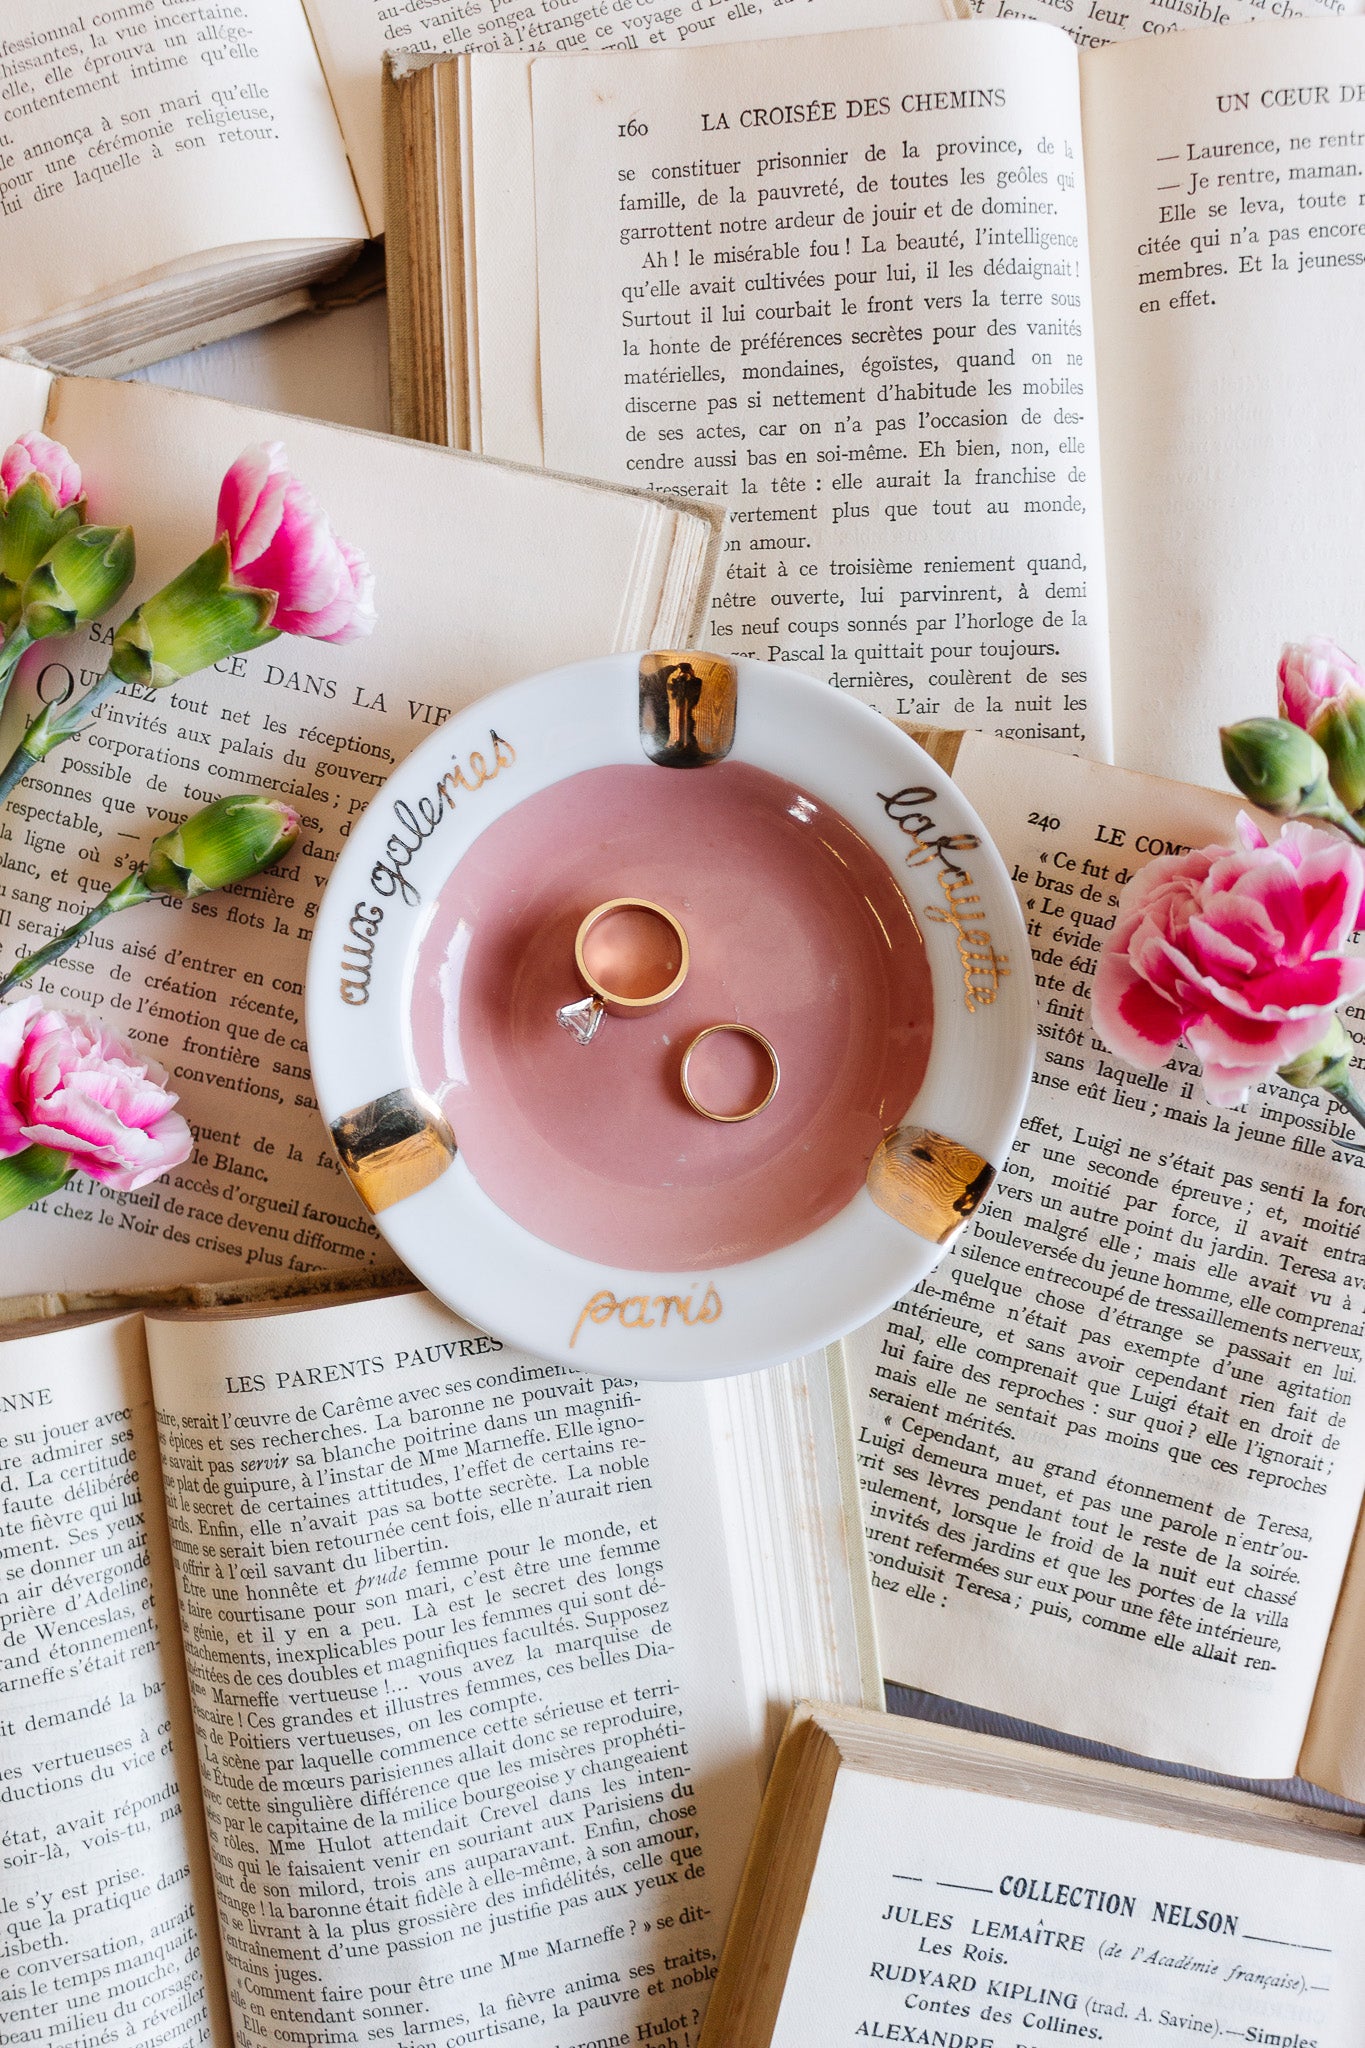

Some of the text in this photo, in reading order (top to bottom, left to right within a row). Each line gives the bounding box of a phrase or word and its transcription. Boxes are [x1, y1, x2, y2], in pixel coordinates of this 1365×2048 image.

[384, 1, 482, 40] des vanités
[442, 8, 536, 45] elle songea
[502, 4, 608, 46] à l'étrangeté
[4, 54, 189, 123] contentement intime
[1215, 86, 1330, 114] UN CŒUR
[23, 89, 202, 161] annonça à son mari
[617, 88, 1006, 138] 160 LA CROISÉE DES CHEMINS
[44, 120, 175, 174] une cérémonie
[73, 127, 279, 187] laquelle à son retour.
[1186, 139, 1280, 162] Laurence,
[619, 165, 1075, 211] famille, de la pauvreté, de toutes les geôles qui
[1186, 164, 1363, 196] Je rentre, maman.
[1158, 191, 1347, 224] Elle se leva, toute
[1137, 226, 1300, 256] citée qui n'a pas
[1138, 253, 1289, 286] membres. Et la
[1139, 289, 1216, 314] en effet.
[710, 609, 1088, 638] les neuf coups sonnés par l'horloge de la
[767, 639, 1060, 665] Pascal la quittait pour toujours.
[263, 664, 388, 713] DANS LA
[828, 666, 1088, 690] dernières, coulèrent de ses
[90, 702, 307, 769] d'invités aux palais du
[170, 692, 397, 767] tout net les réceptions,
[1027, 811, 1127, 848] 240 LE
[109, 963, 217, 1003] de création
[121, 940, 264, 987] aisé d'entrer en
[181, 1035, 260, 1069] frontière
[1044, 1051, 1194, 1100] sans laquelle il
[568, 1280, 722, 1350] paris
[224, 1336, 504, 1394] LES PARENTS PAUVRES
[26, 1447, 139, 1488] La certitude
[267, 1437, 647, 1513] certaines attitudes, l'effet de certains re-
[269, 1476, 653, 1556] bien retournée cent fois, elle n'aurait rien
[1011, 1453, 1313, 1543] au grand étonnement de Teresa,
[1071, 1513, 1300, 1585] tout le reste de la soirée.
[1029, 1599, 1277, 1672] puis, comme elle allait ren-
[999, 1875, 1239, 1936] COLLECTION NELSON
[881, 1904, 954, 1931] JULES
[971, 1918, 1086, 1953] LEMAÎTRE
[1098, 1939, 1123, 1961] (de
[1130, 1946, 1219, 1975] l'Académie
[917, 1936, 1008, 1965] Les Rois.
[478, 1948, 717, 2018] la fièvre anima ses traits,
[869, 1961, 977, 1992] RUDYARD
[986, 1979, 1078, 2010] KIPLING
[1084, 1996, 1128, 2019] (trad.
[1134, 2006, 1152, 2023] A.
[904, 1993, 1103, 2041] Contes des Collines.
